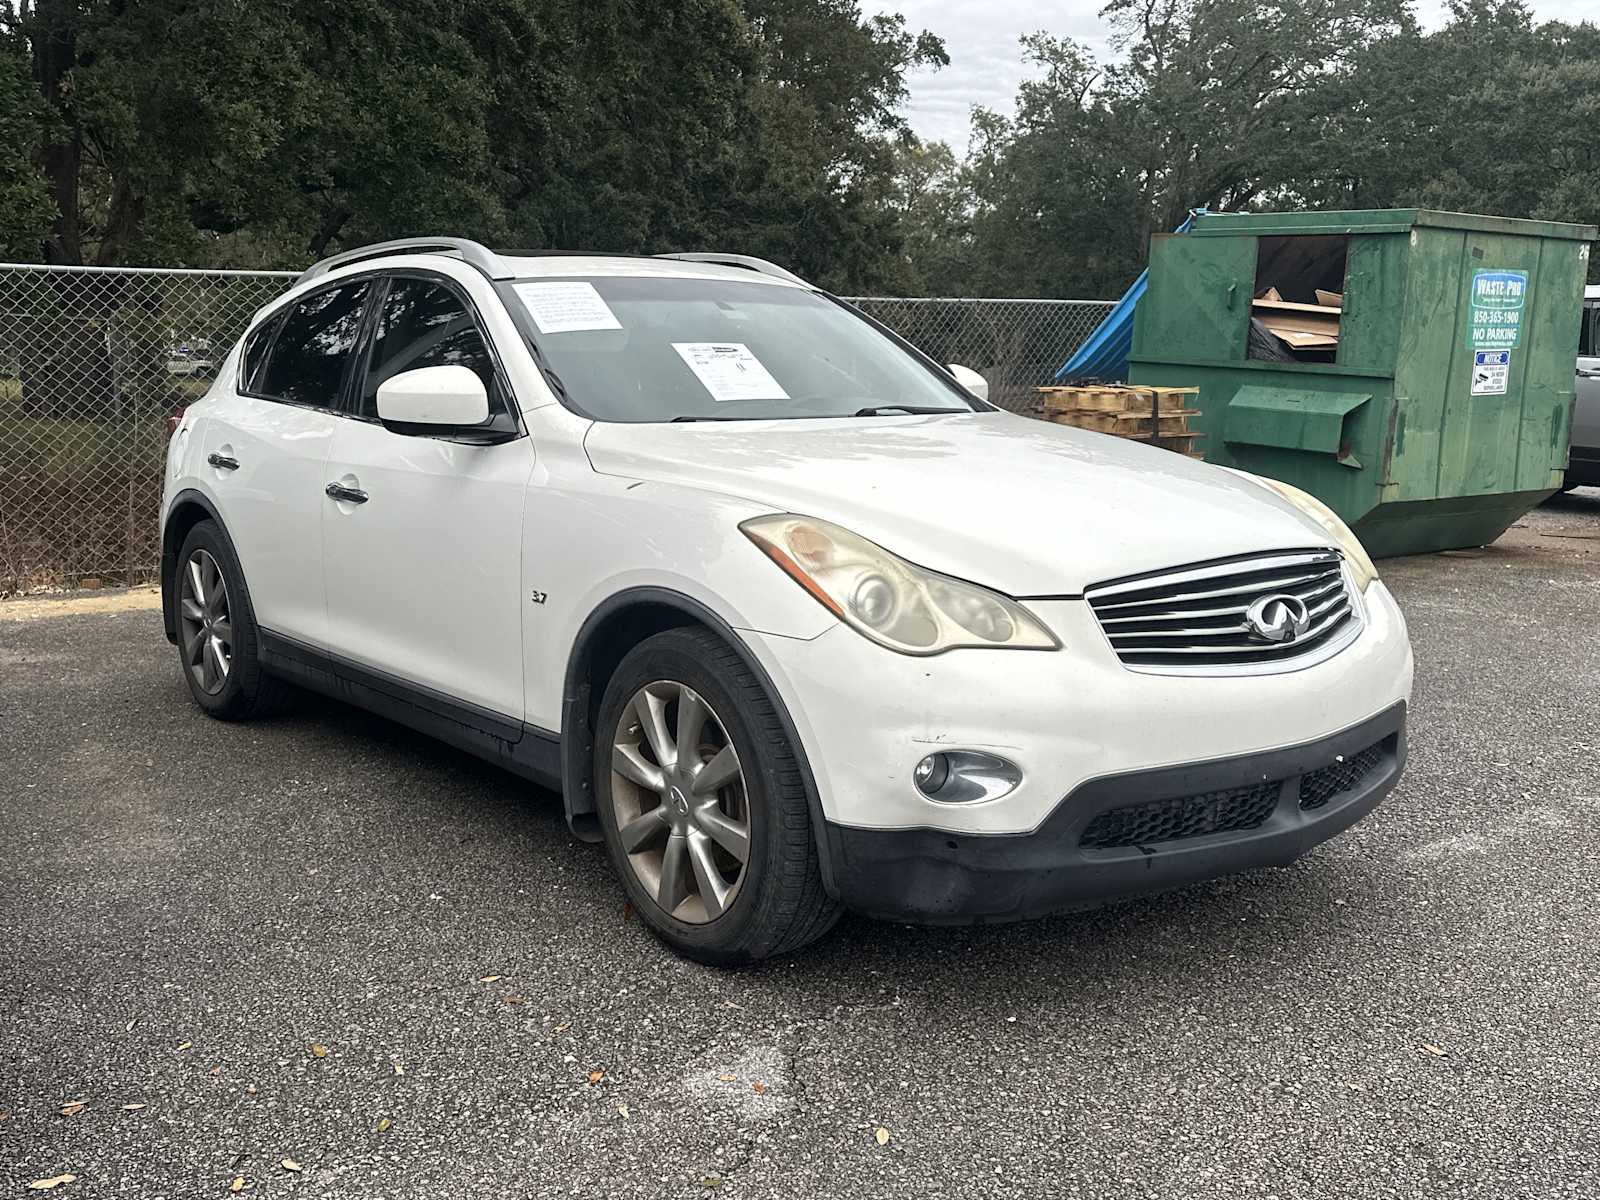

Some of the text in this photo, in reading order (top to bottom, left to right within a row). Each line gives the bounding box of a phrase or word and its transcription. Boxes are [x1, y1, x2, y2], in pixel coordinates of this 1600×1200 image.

[1478, 279, 1521, 296] WASTE PRO
[1474, 311, 1519, 324] 850-365-1900
[1472, 328, 1517, 341] NO PARKING
